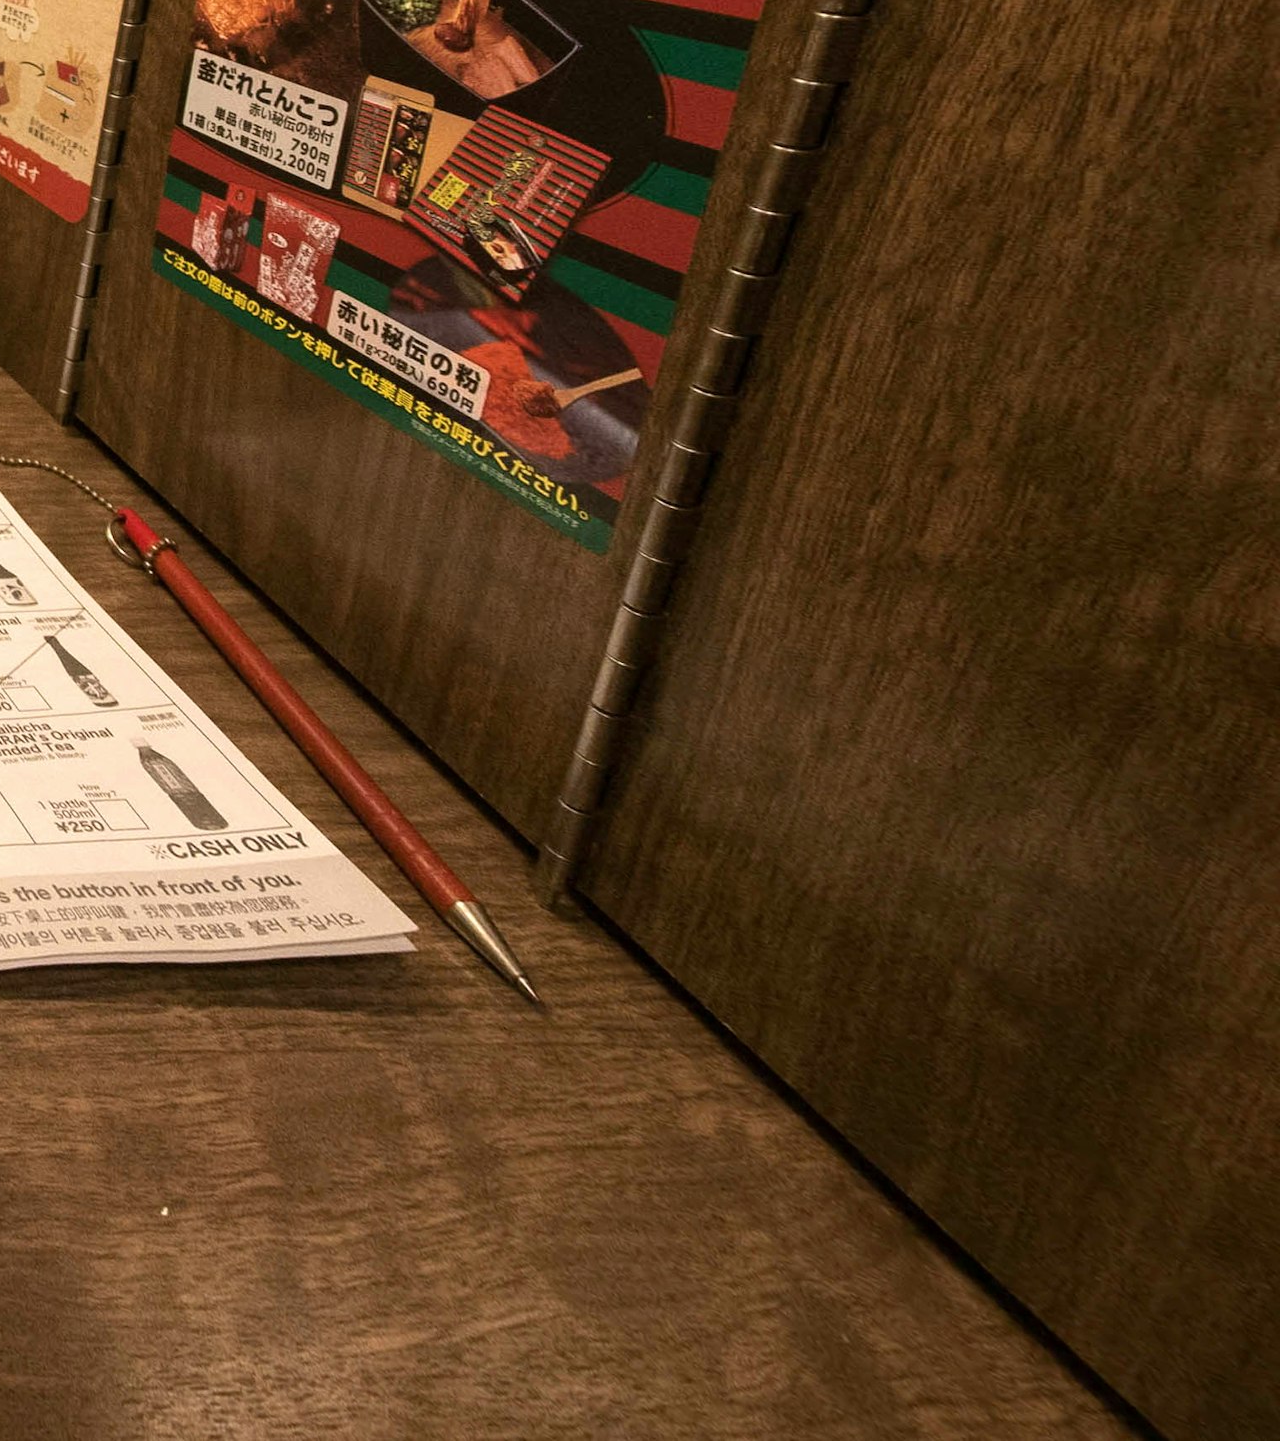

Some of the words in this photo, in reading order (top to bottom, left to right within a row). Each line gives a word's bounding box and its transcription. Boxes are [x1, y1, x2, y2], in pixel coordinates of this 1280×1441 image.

[196, 57, 340, 127] 釜だれとんこつ
[214, 106, 278, 144] 単品(替玉付)
[290, 137, 331, 167] 790円
[248, 102, 335, 147] 赤い秘伝の粉付
[273, 148, 328, 183] 2,200円
[337, 298, 483, 396] 赤い秘伝の粉
[162, 246, 590, 522] ご注文の際は前のボタンを押して従業員をお呼びください。
[426, 376, 476, 414] 690円
[46, 741, 76, 753] Tea
[50, 727, 114, 741] Original
[49, 799, 89, 810] bottle
[53, 808, 97, 820] 500ml
[55, 820, 105, 834] ¥250
[240, 830, 312, 853] ONLY
[12, 885, 52, 903] the
[52, 883, 129, 900] button
[132, 881, 154, 897] in
[157, 878, 221, 896] front
[220, 873, 248, 893] of
[248, 873, 303, 893] you.
[61, 922, 115, 943] 버튼을
[119, 924, 173, 943] 눌러서
[176, 919, 246, 940] 종업원을
[247, 917, 287, 935] 불러
[286, 911, 366, 933] 주십시오.
